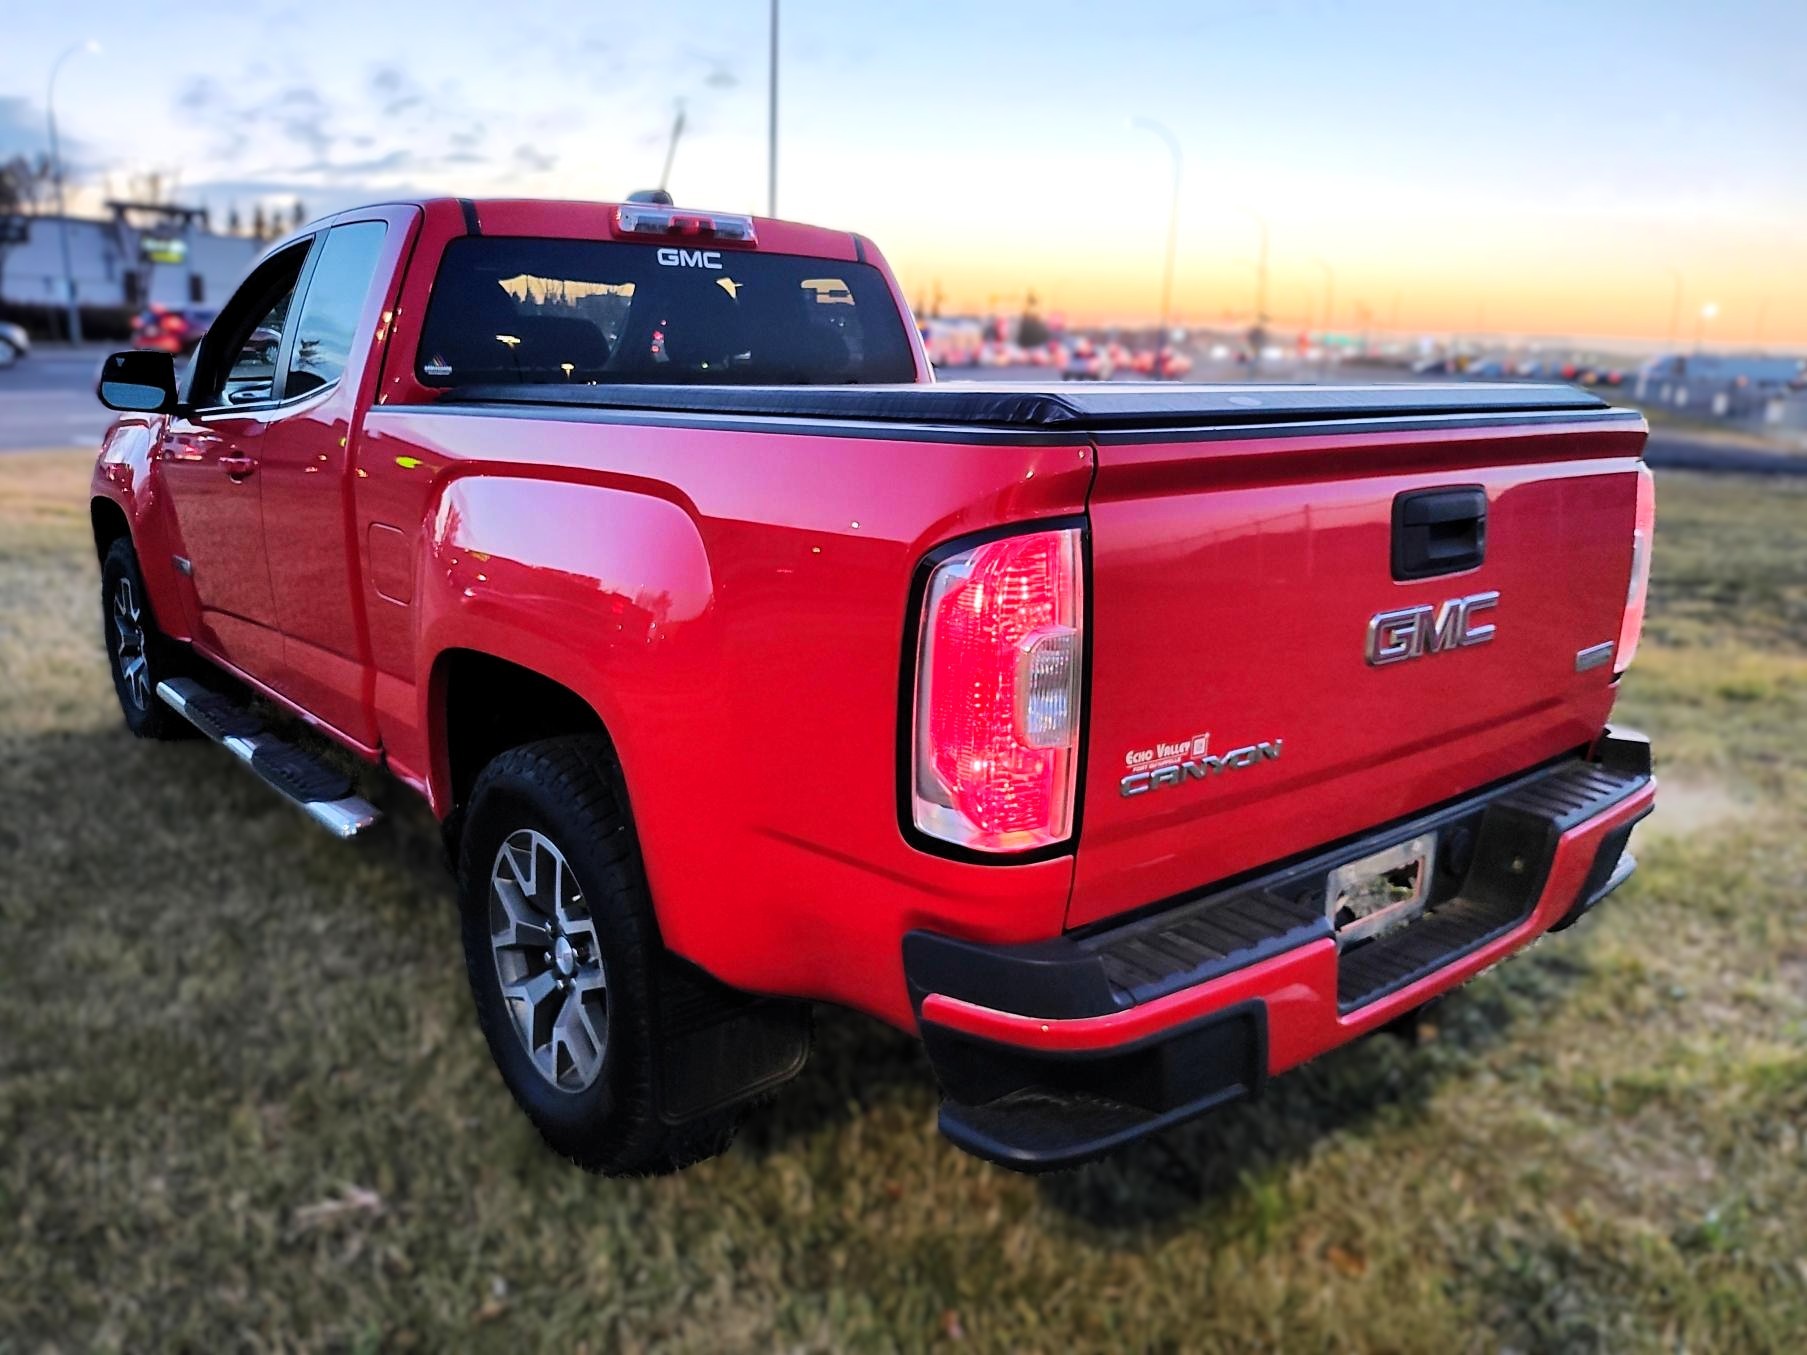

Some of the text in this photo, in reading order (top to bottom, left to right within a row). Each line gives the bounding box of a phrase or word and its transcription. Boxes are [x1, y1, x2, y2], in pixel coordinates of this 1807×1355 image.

[657, 248, 723, 269] GMC
[1366, 590, 1500, 666] GMC
[1120, 738, 1284, 798] CANYON
